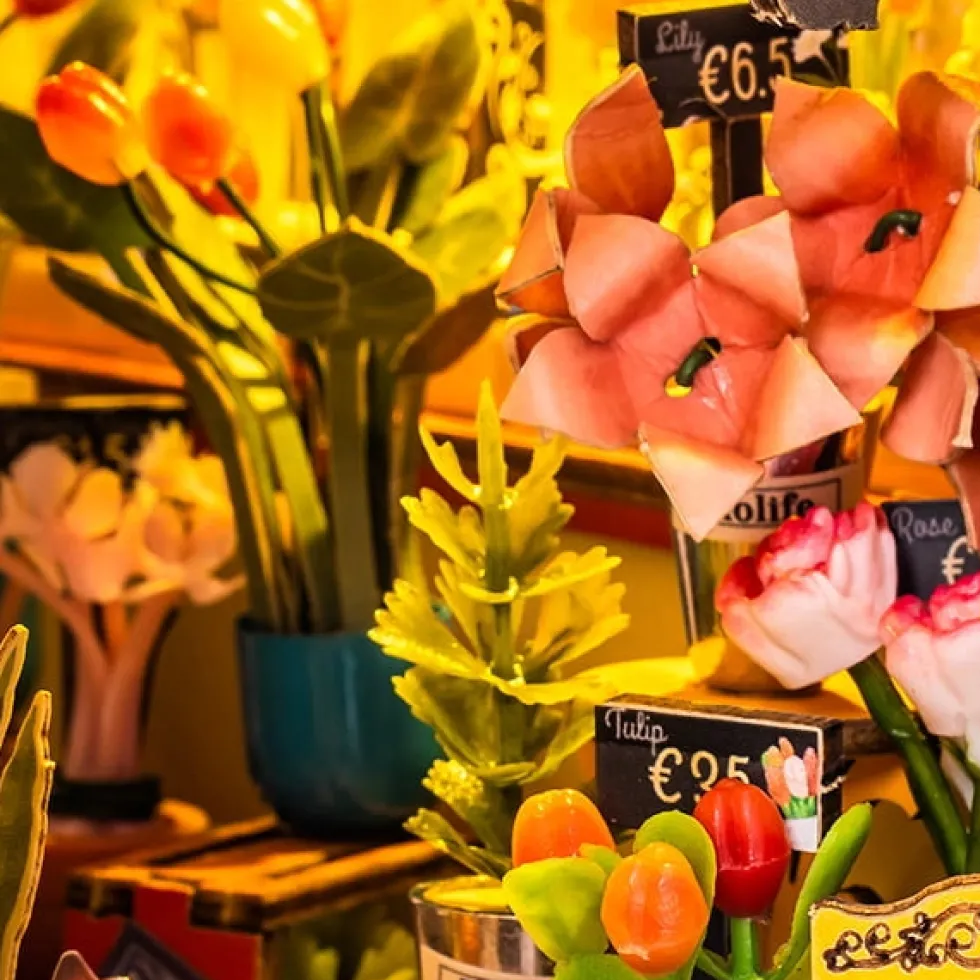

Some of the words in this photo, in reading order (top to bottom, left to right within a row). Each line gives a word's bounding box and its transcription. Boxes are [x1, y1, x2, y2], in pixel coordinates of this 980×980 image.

[656, 19, 705, 63] Lily
[722, 490, 816, 522] olife
[890, 506, 959, 544] Rose
[604, 707, 669, 757] Tulip
